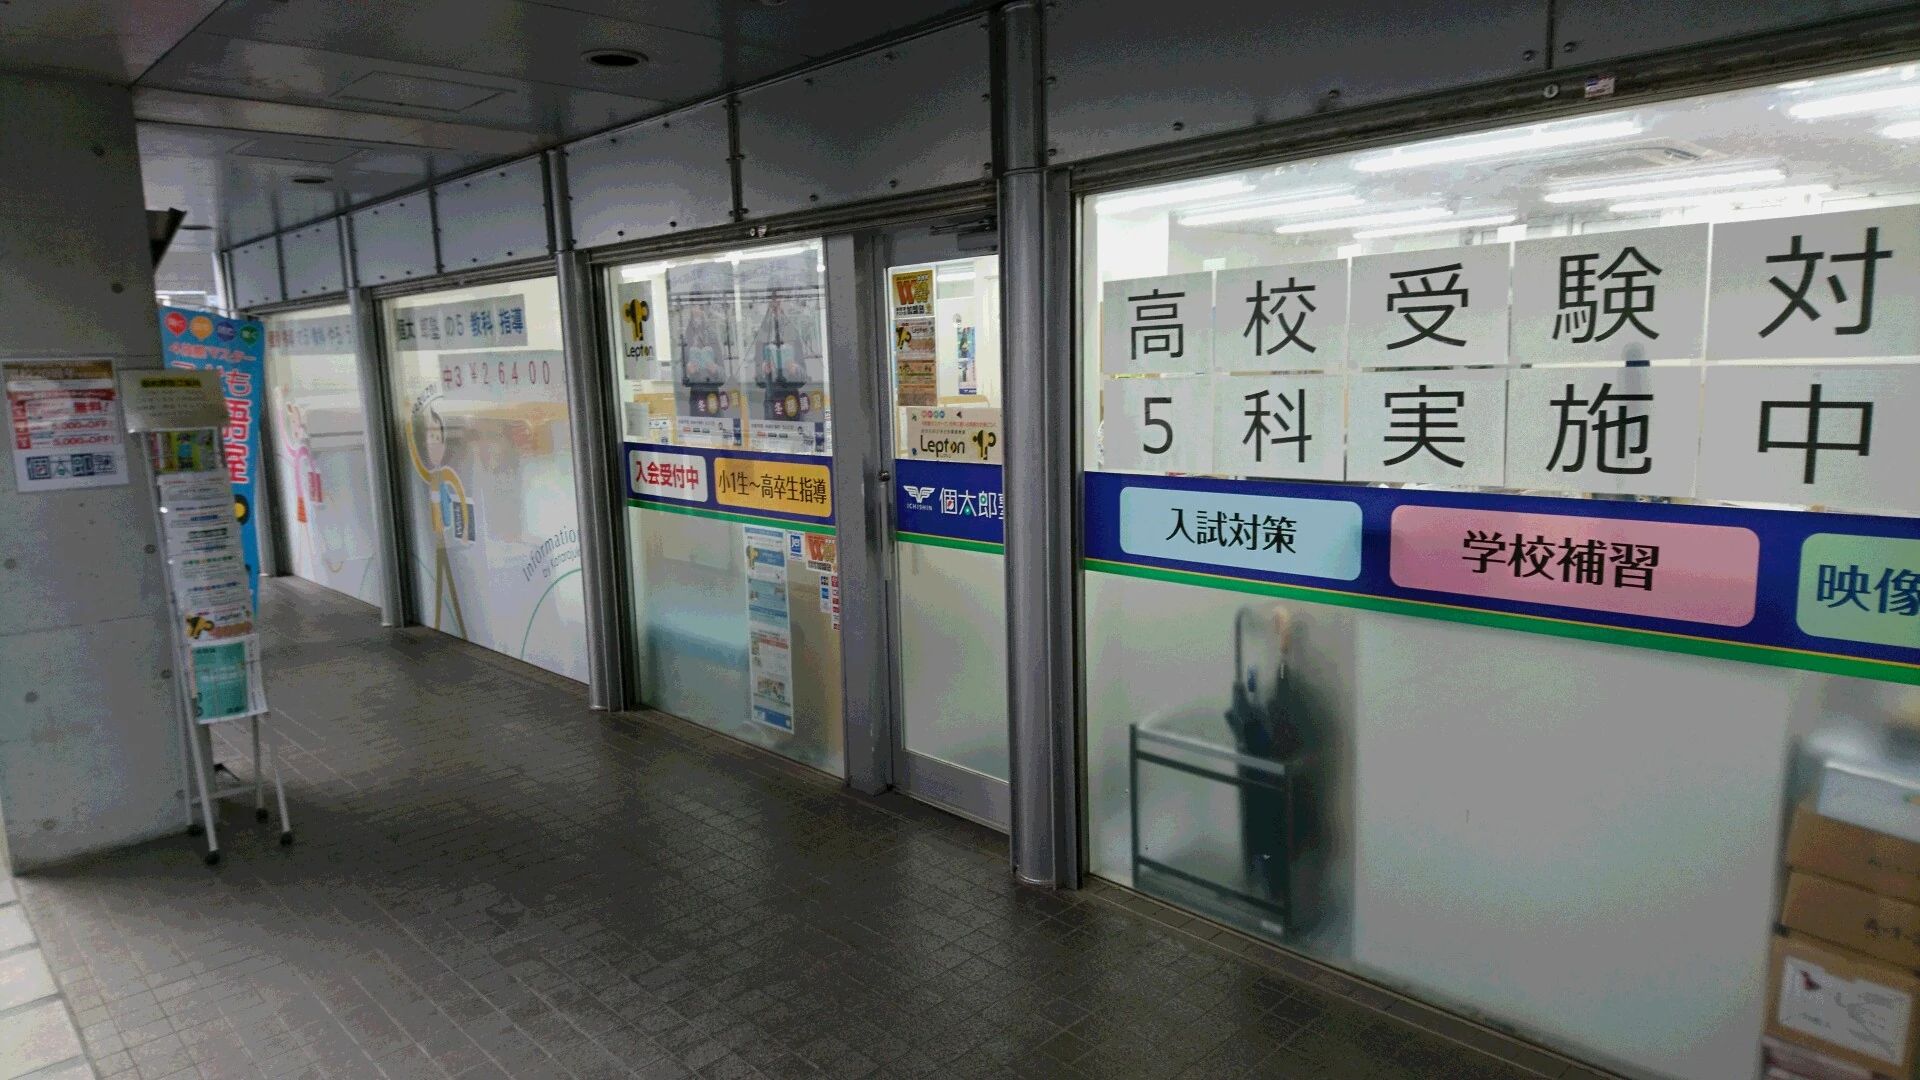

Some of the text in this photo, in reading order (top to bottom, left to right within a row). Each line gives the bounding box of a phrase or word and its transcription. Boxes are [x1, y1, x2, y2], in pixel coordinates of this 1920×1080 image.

[1128, 226, 1893, 360] 高校受験対
[625, 343, 654, 362] Lepton
[920, 434, 966, 458] Lepton
[1143, 383, 1874, 484] 5科実施中
[635, 461, 699, 490] 入会受付中
[1165, 508, 1297, 554] 入試対策
[1461, 530, 1660, 591] 学校補習
[1816, 564, 1920, 617] 映像
